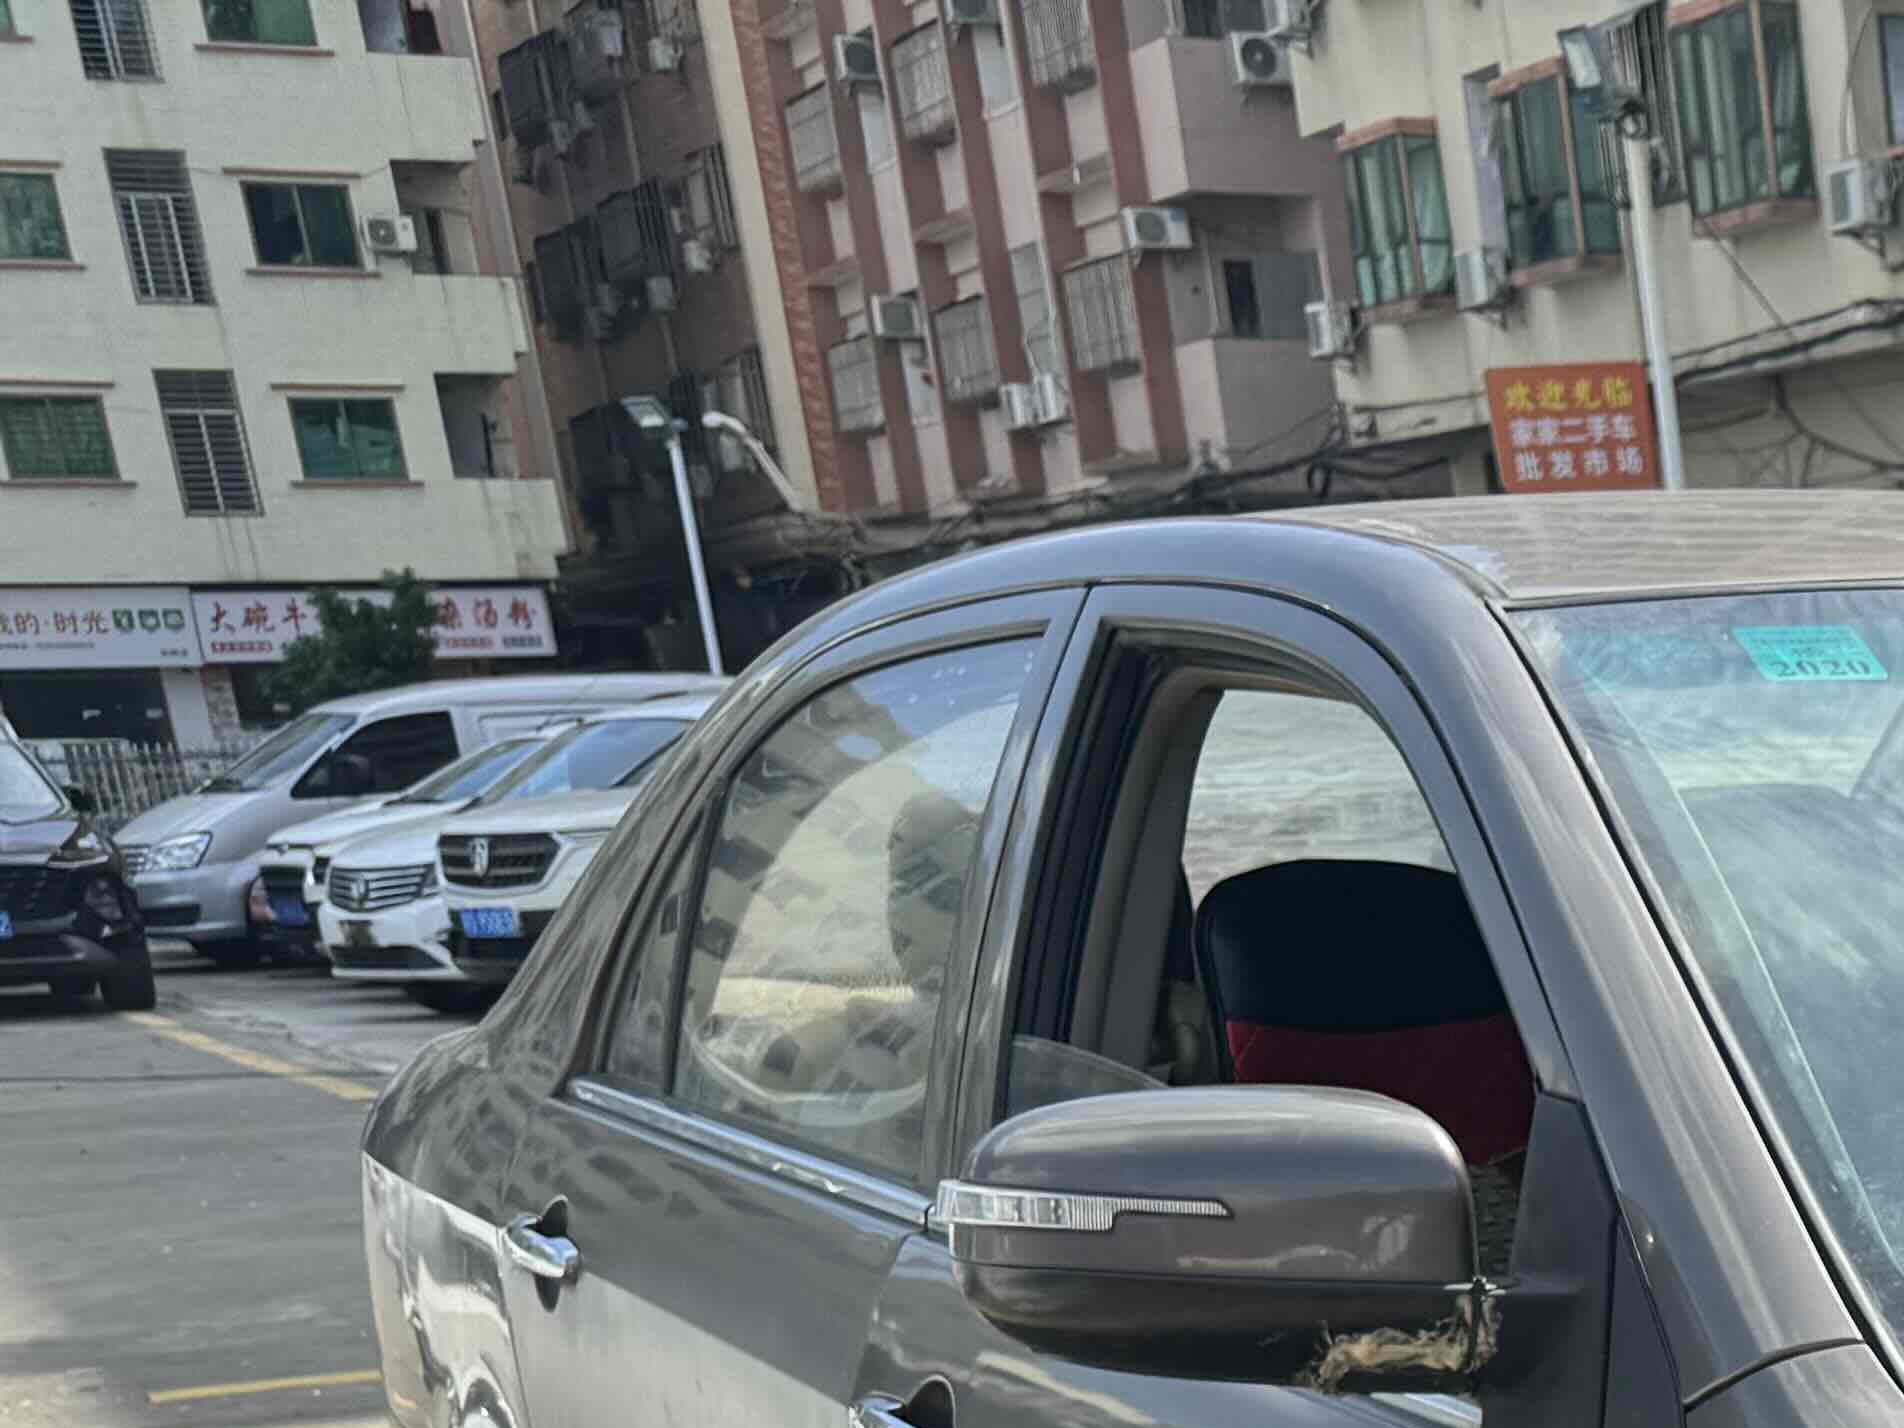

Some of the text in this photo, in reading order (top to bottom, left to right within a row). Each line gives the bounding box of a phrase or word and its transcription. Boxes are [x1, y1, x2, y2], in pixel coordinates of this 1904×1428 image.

[1504, 376, 1634, 411] 欢迎光临
[1510, 413, 1636, 447] 家家二手车
[1515, 446, 1643, 481] 批发市场
[1769, 660, 1871, 677] 2020
